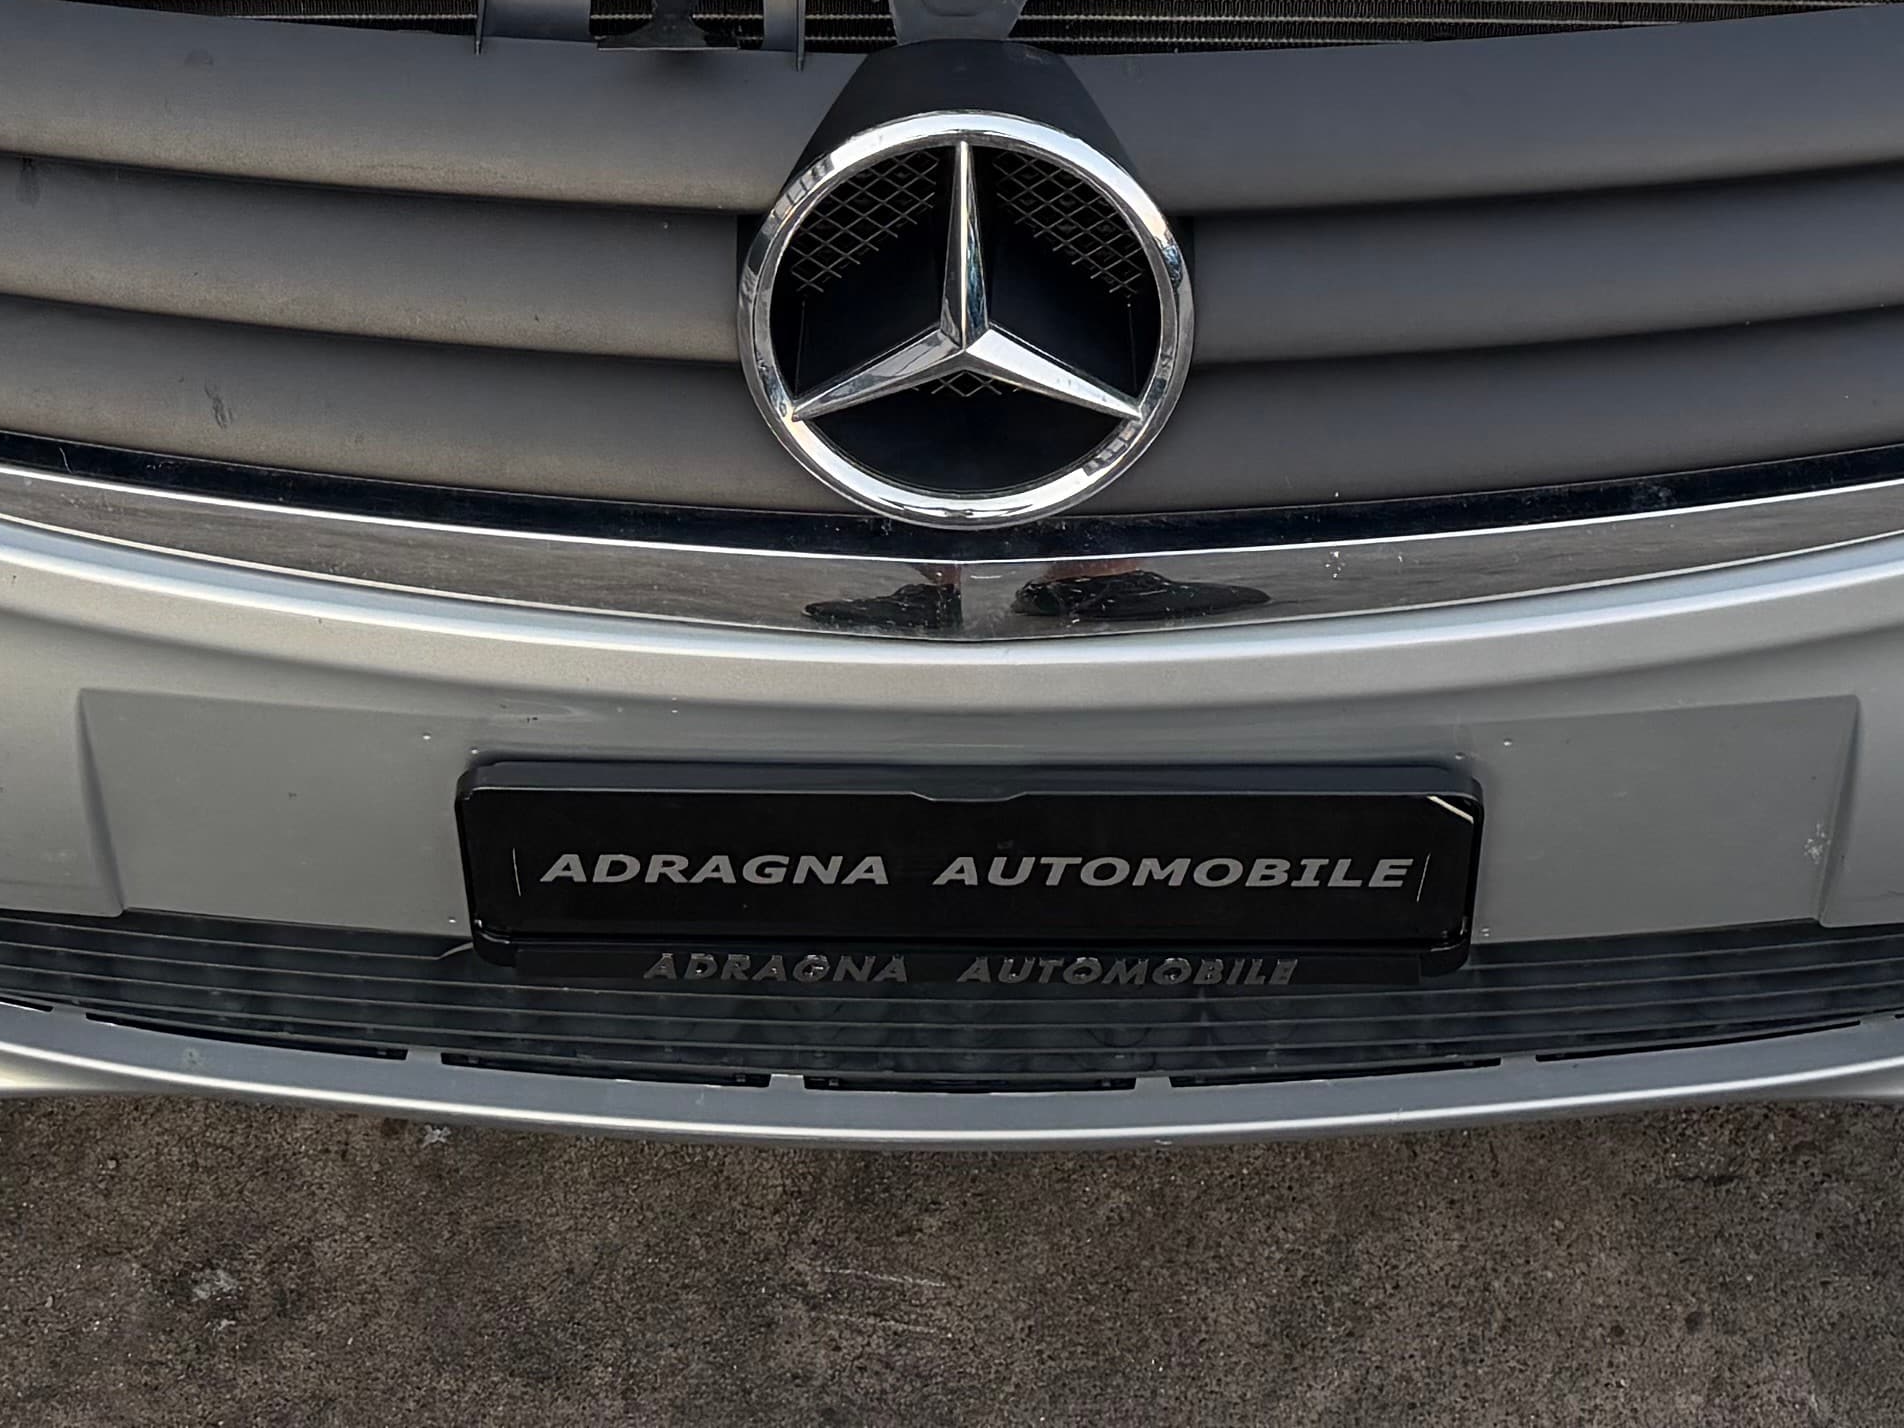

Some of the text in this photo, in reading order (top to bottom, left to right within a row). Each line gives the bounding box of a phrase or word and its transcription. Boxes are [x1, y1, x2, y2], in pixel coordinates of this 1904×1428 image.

[539, 853, 1414, 888] ADRAGNA AUTOMOBILE
[643, 952, 1299, 986] ADRAGNA AUTOMOBILE
